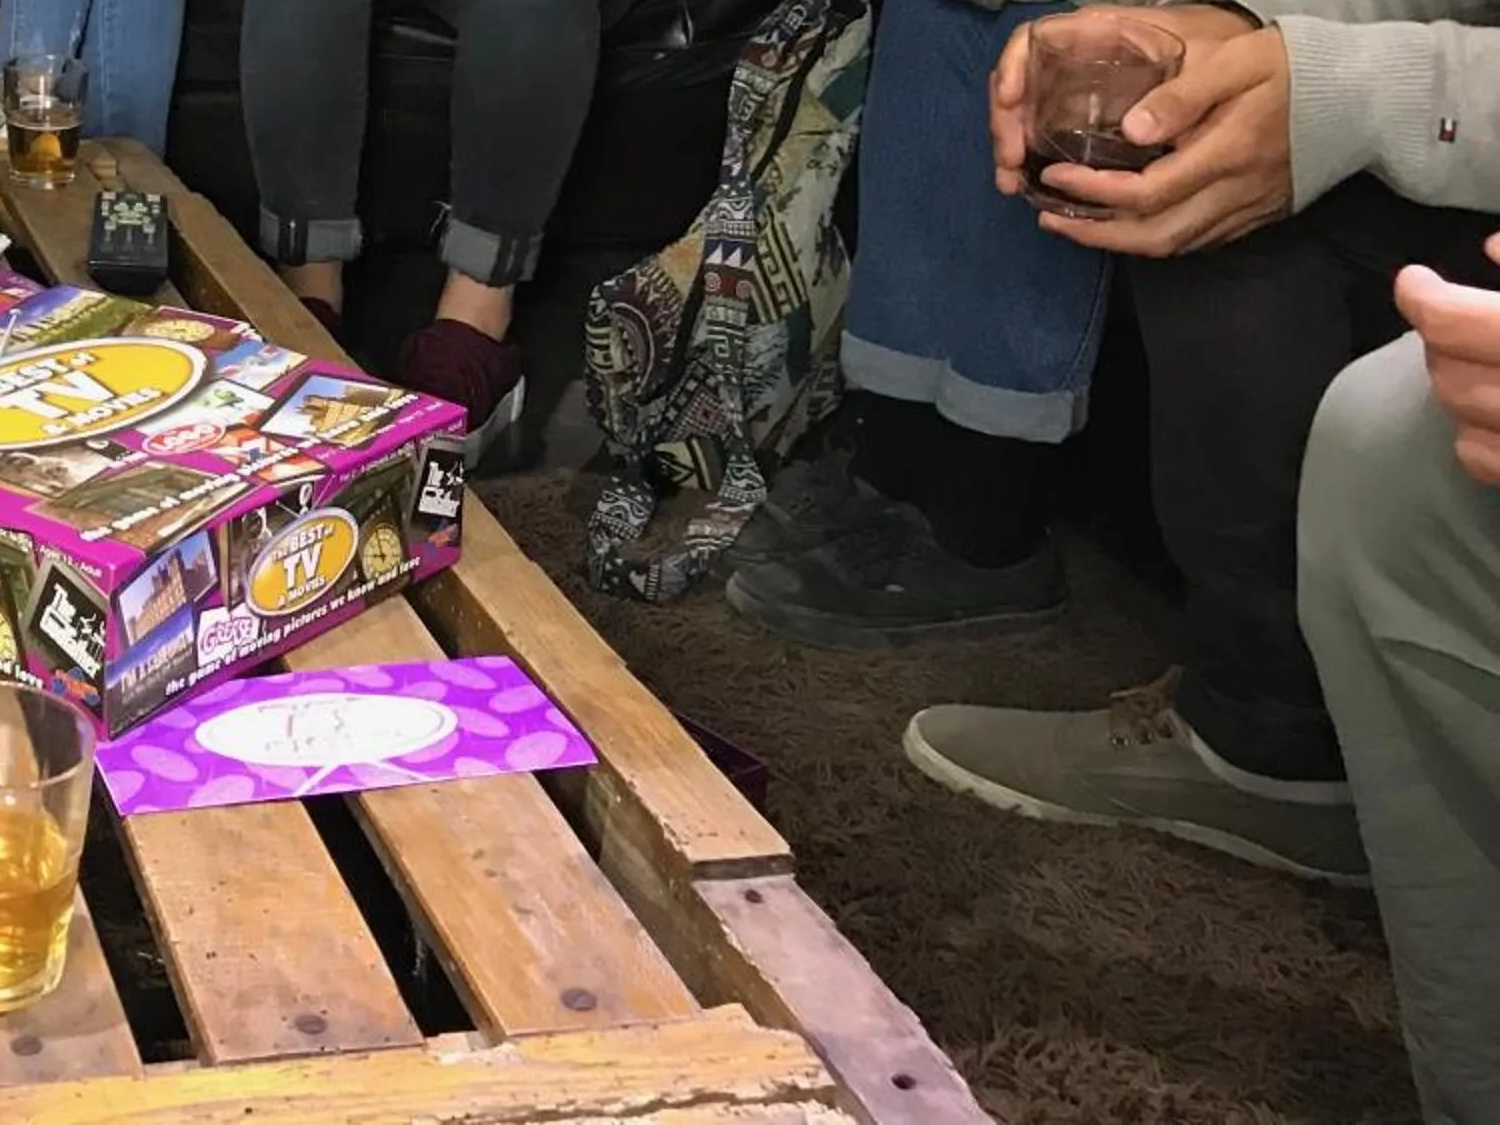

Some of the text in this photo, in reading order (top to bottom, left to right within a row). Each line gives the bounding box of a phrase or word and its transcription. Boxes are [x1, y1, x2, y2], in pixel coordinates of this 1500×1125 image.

[73, 387, 164, 425] MOVIES
[290, 522, 325, 555] BEST
[284, 542, 323, 591] TV
[288, 575, 325, 603] MOVIES
[165, 556, 420, 696] the game of moving pictures we know and love
[14, 664, 45, 689] love
